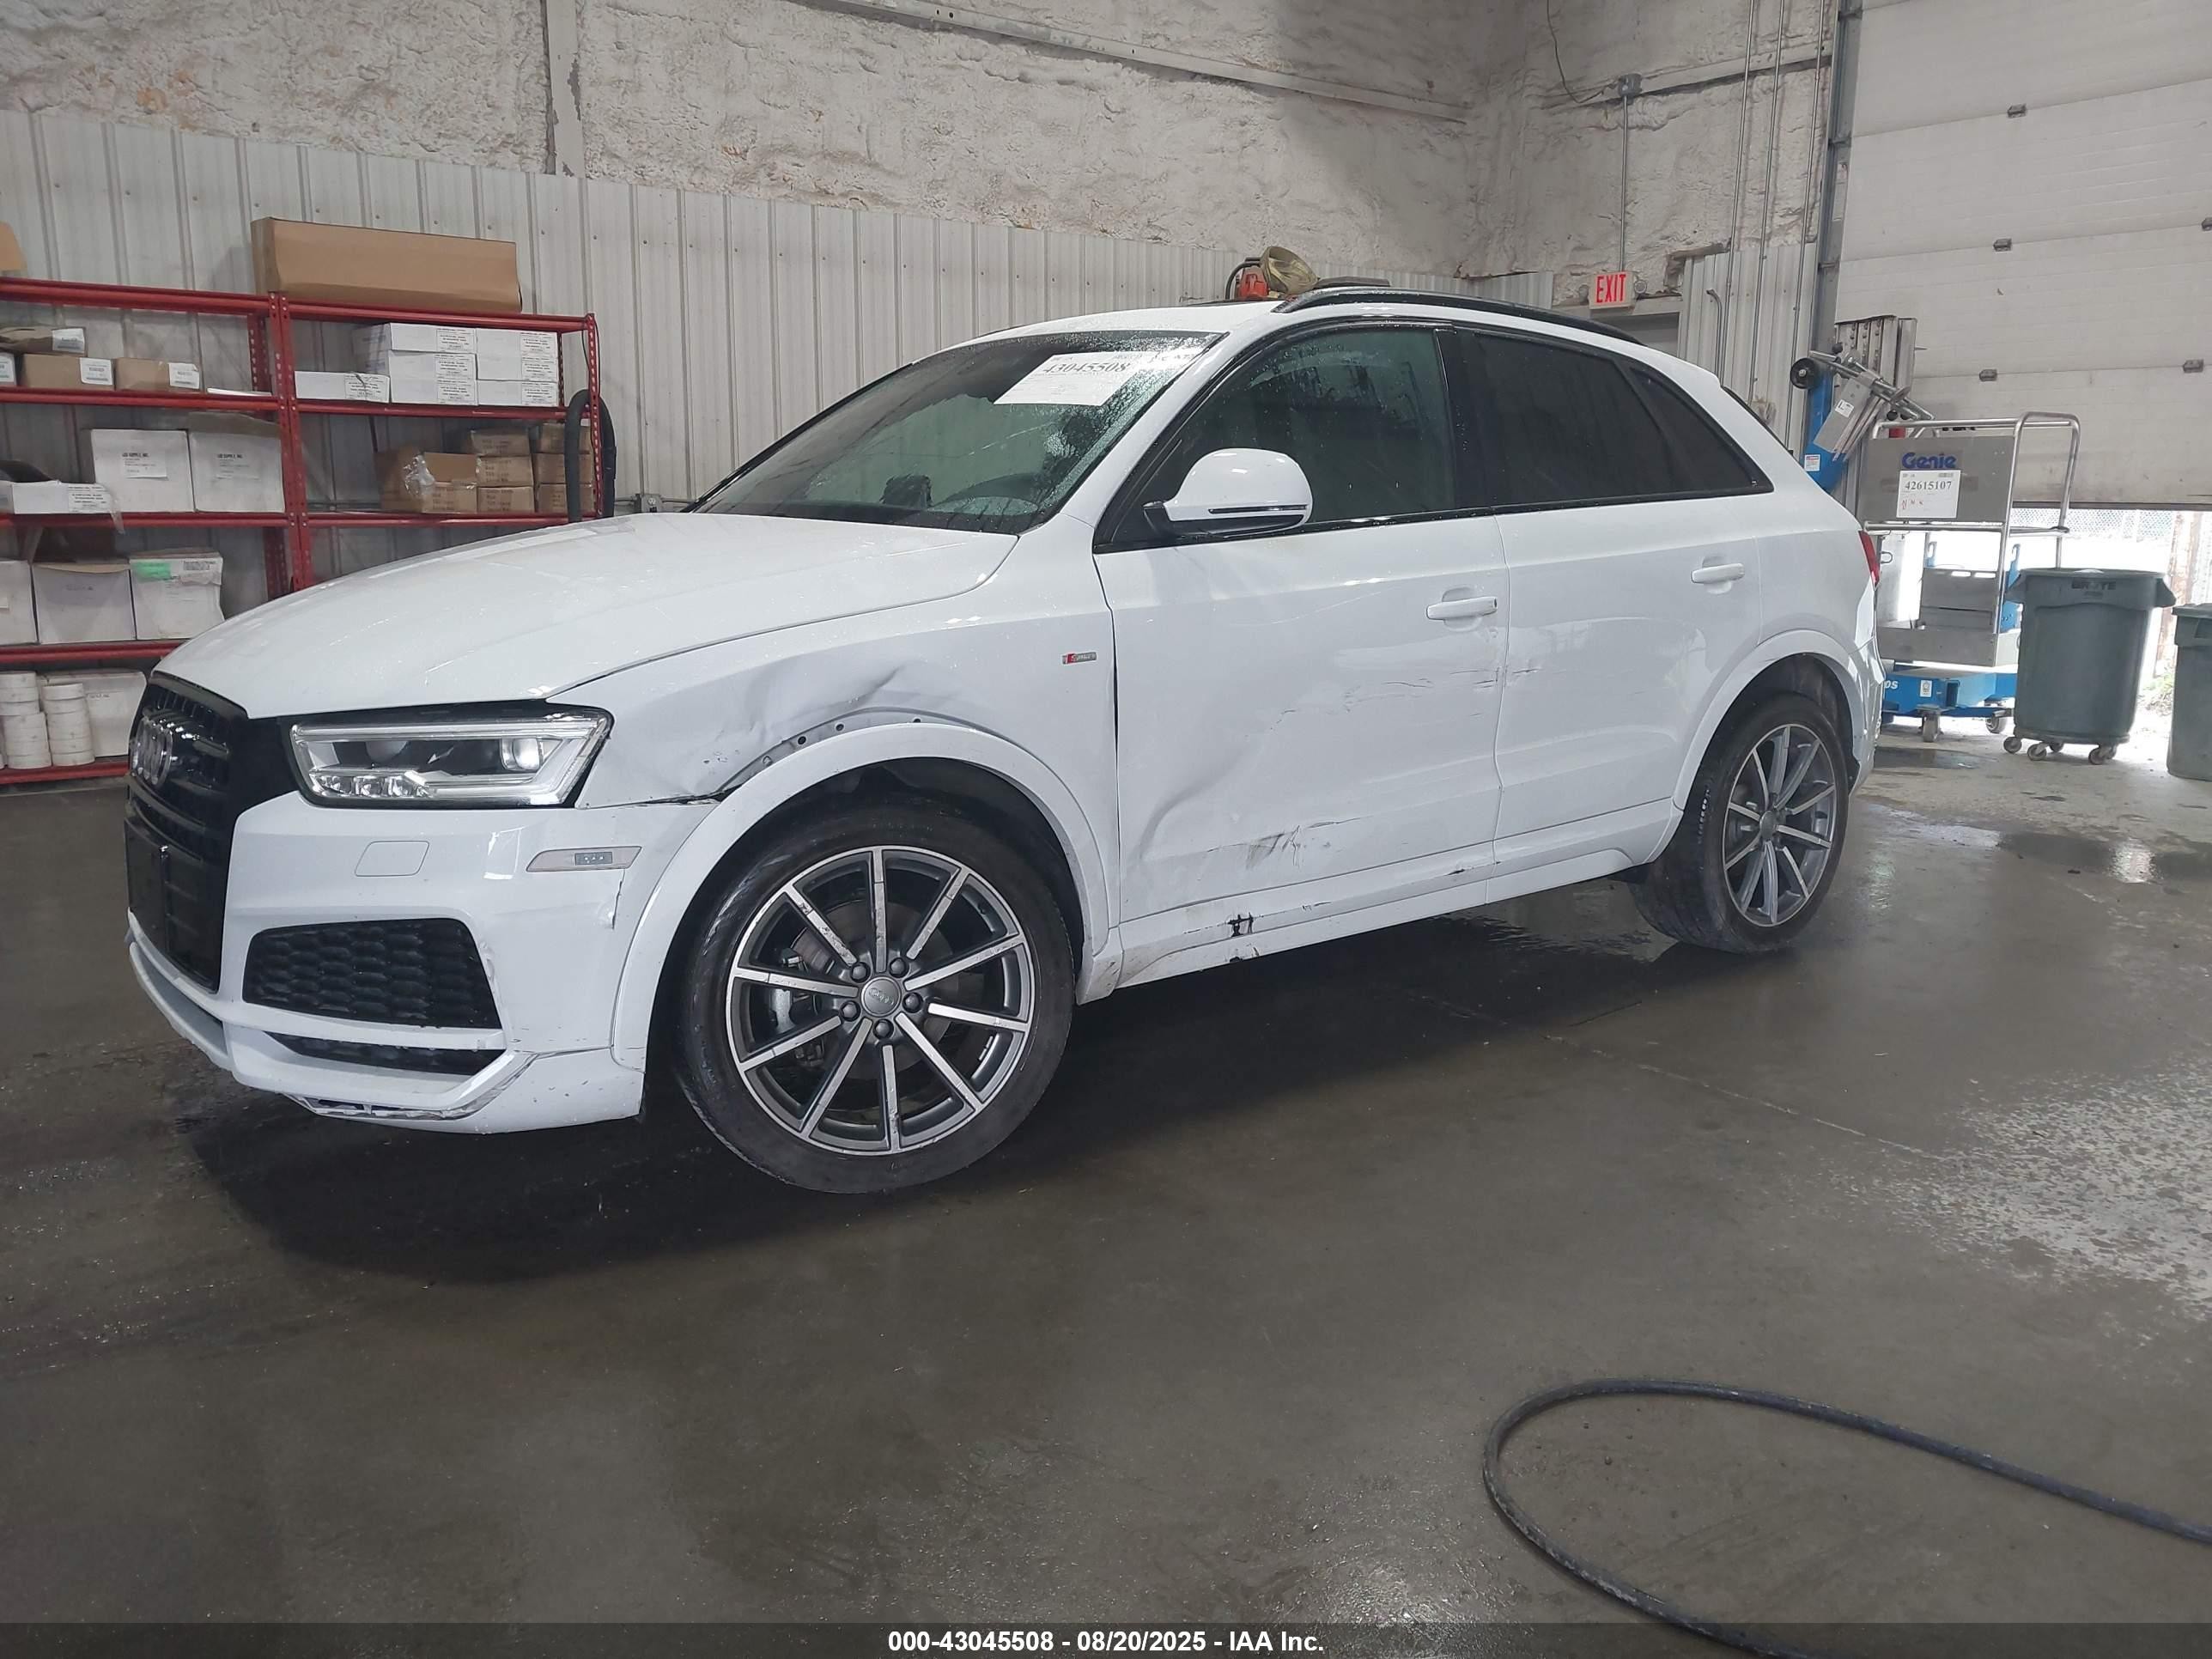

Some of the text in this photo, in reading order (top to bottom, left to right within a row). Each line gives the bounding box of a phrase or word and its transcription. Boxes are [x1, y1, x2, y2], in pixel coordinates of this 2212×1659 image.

[1596, 274, 1626, 303] EXIT
[1043, 362, 1132, 373] 43045508
[1901, 452, 1957, 470] Genie
[1905, 480, 1952, 490] 42615107
